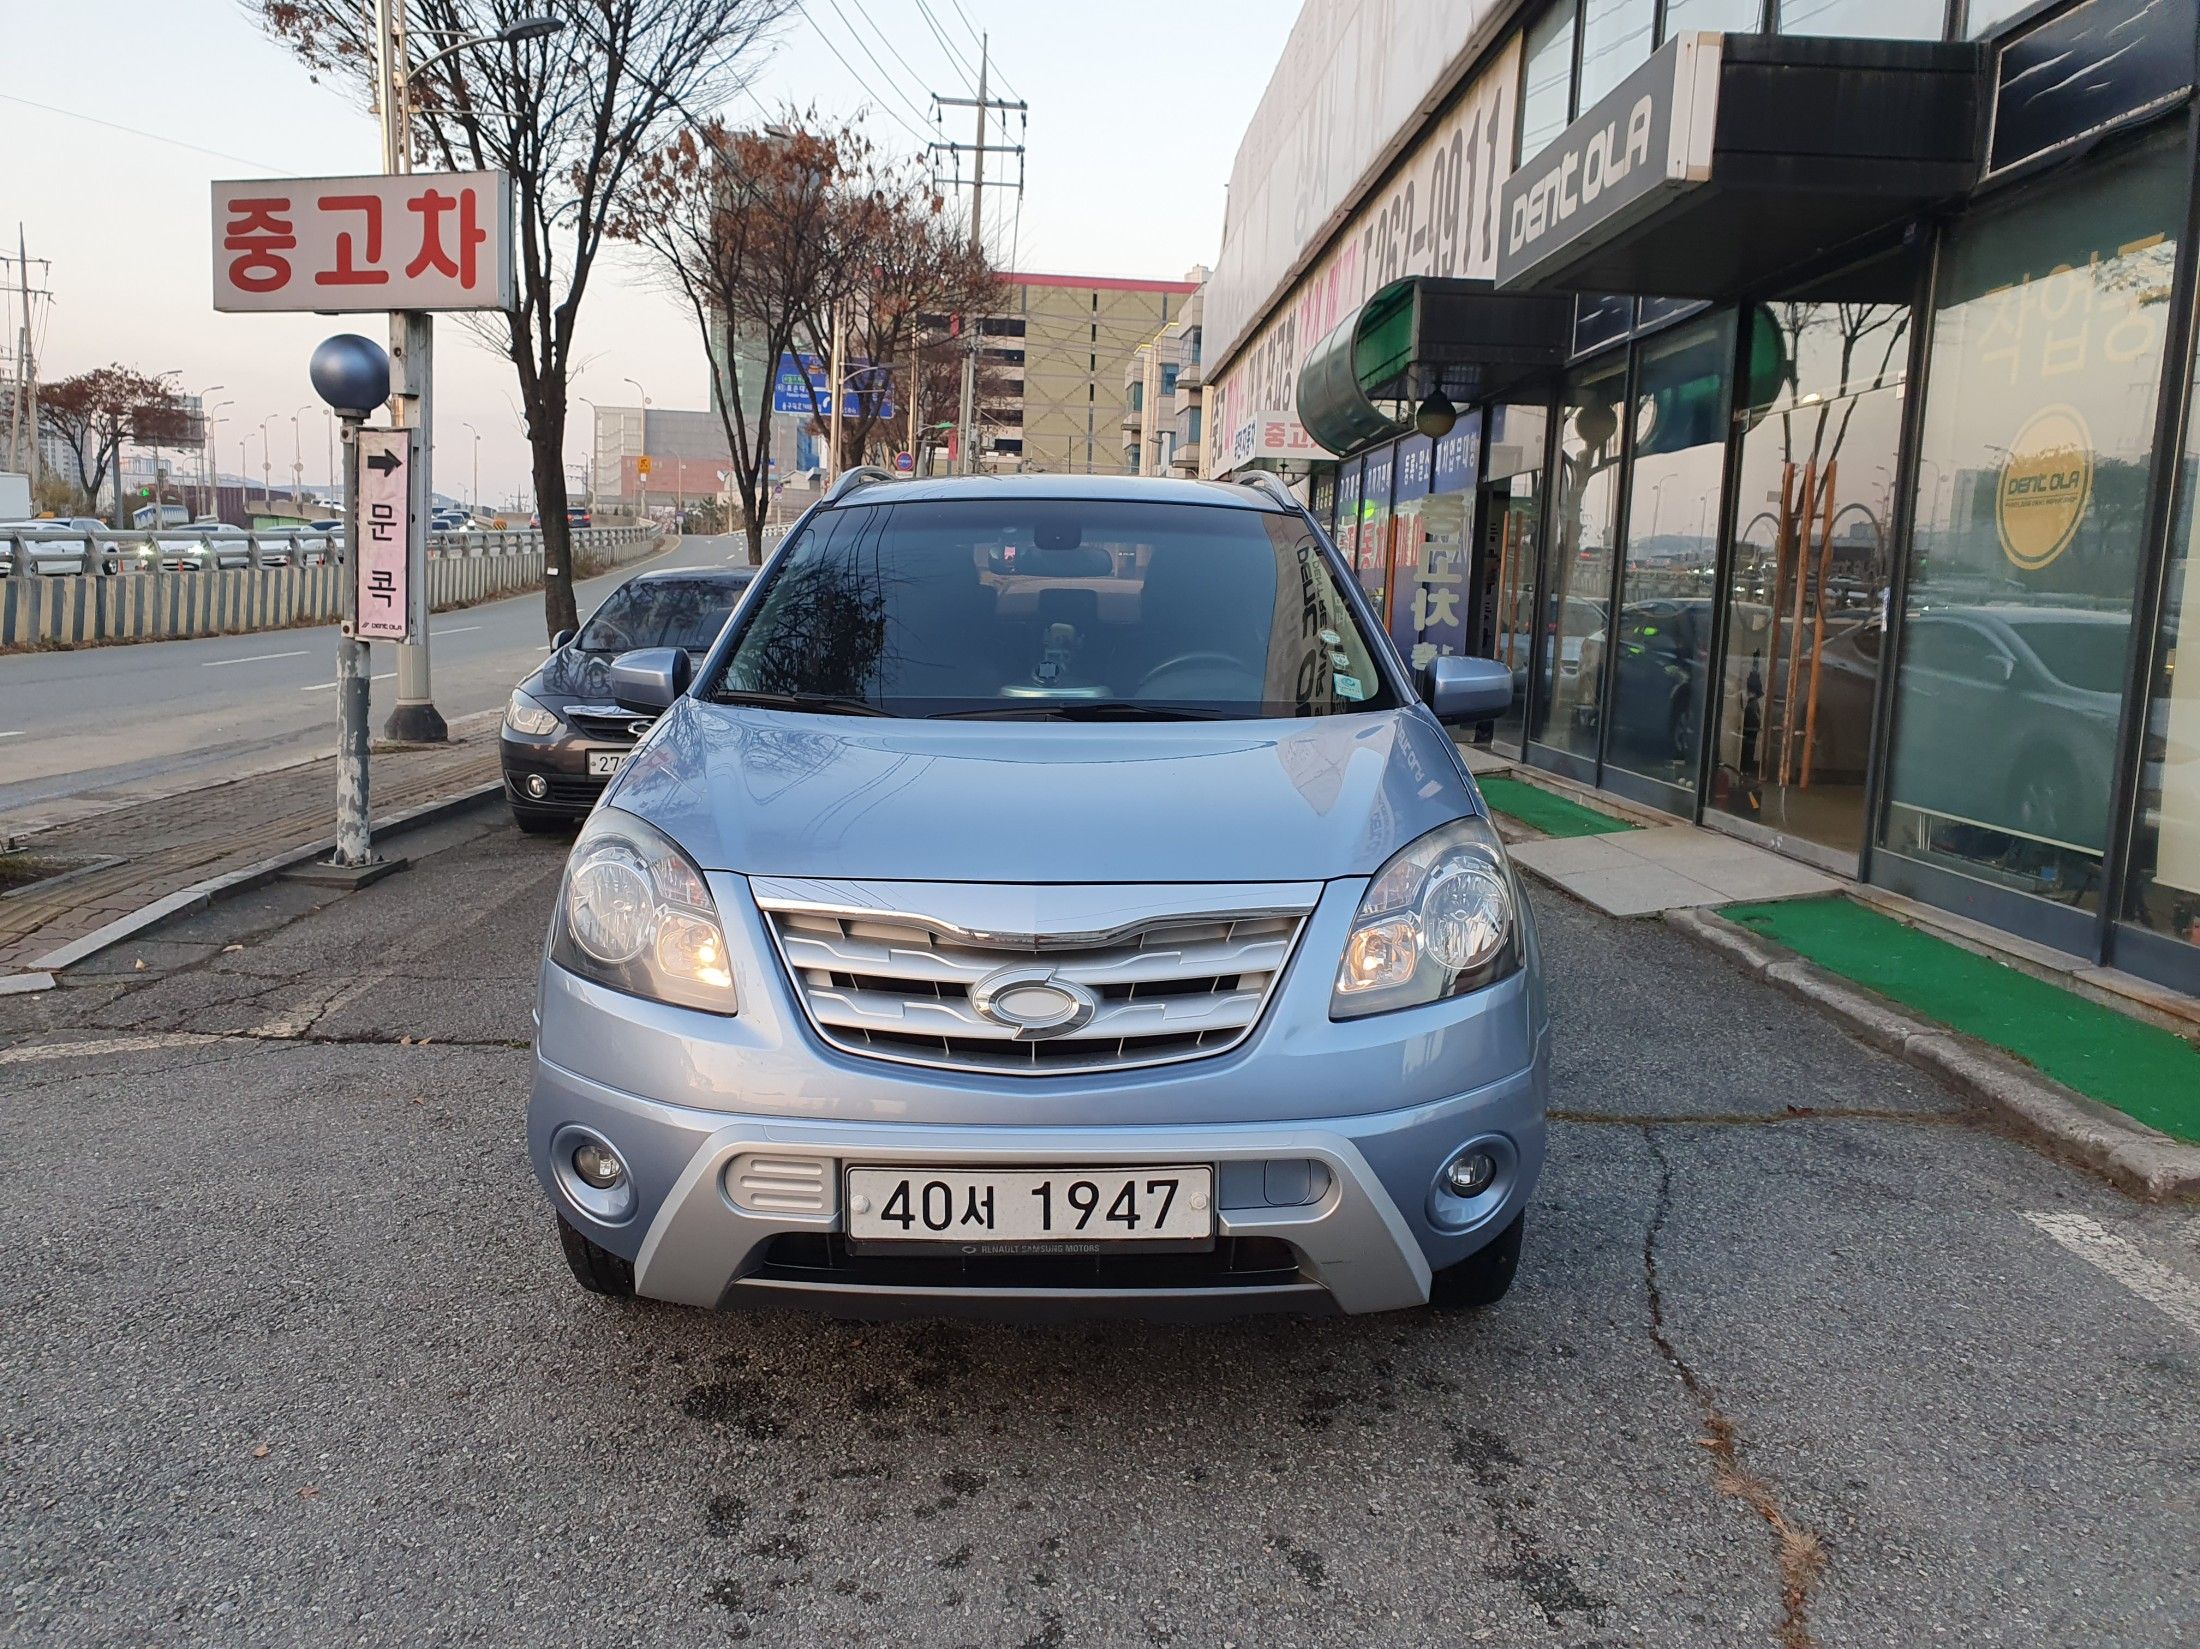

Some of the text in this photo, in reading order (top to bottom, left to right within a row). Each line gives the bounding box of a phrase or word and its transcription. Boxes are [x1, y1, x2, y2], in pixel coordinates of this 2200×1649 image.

[1582, 93, 1653, 205] OLA
[223, 187, 487, 293] 중고차
[1264, 420, 1322, 449] 중고
[2050, 470, 2080, 492] OLA
[367, 502, 398, 609] 문콕
[389, 623, 403, 631] OLA
[599, 756, 627, 772] 27
[880, 1179, 1180, 1231] 40서 1947
[981, 1243, 1100, 1254] RENAULT SAMSUNG MOTORS
